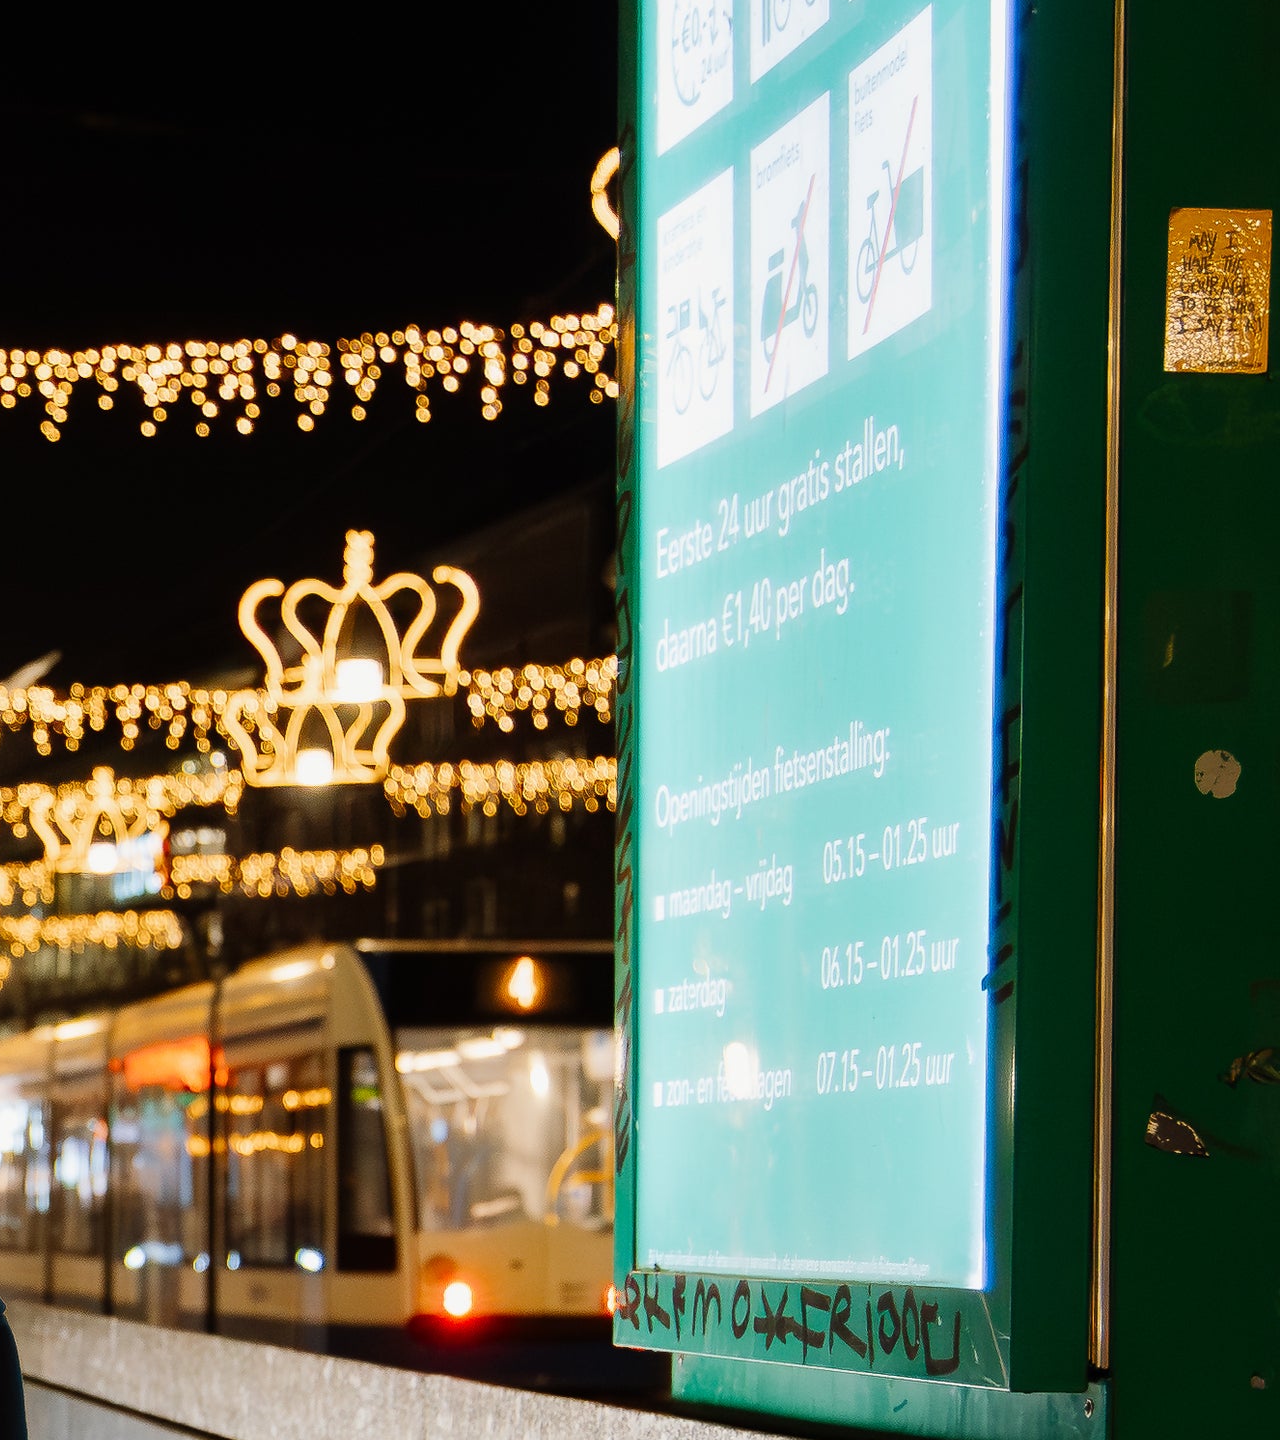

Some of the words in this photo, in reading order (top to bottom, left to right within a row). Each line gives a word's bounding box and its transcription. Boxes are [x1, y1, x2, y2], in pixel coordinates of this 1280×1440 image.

[854, 38, 908, 106] buitenmodel
[657, 518, 712, 580] Eerste
[717, 491, 740, 552] 24
[744, 490, 773, 539] uur
[778, 448, 829, 537] gratis
[834, 415, 905, 494] stallen,
[656, 617, 717, 673] daarna
[722, 576, 772, 649] €1,40
[776, 575, 809, 641] per
[811, 547, 856, 616] dag.
[655, 755, 770, 837] Openingstijden
[775, 720, 891, 795] fietsenstalling:
[669, 868, 732, 919] maandag
[746, 852, 793, 911] vrijdag
[822, 832, 866, 885] 05.15
[882, 816, 928, 871] 01.25
[932, 821, 960, 860] uur
[667, 964, 728, 1018] zaterdag
[820, 940, 865, 990] 06.15
[880, 928, 927, 981] 01.25
[930, 936, 960, 973] uur
[666, 1077, 695, 1107] zon-
[696, 1076, 714, 1104] en
[816, 1049, 860, 1096] 07.15
[875, 1041, 922, 1090] 01.25
[925, 1050, 957, 1087] uur
